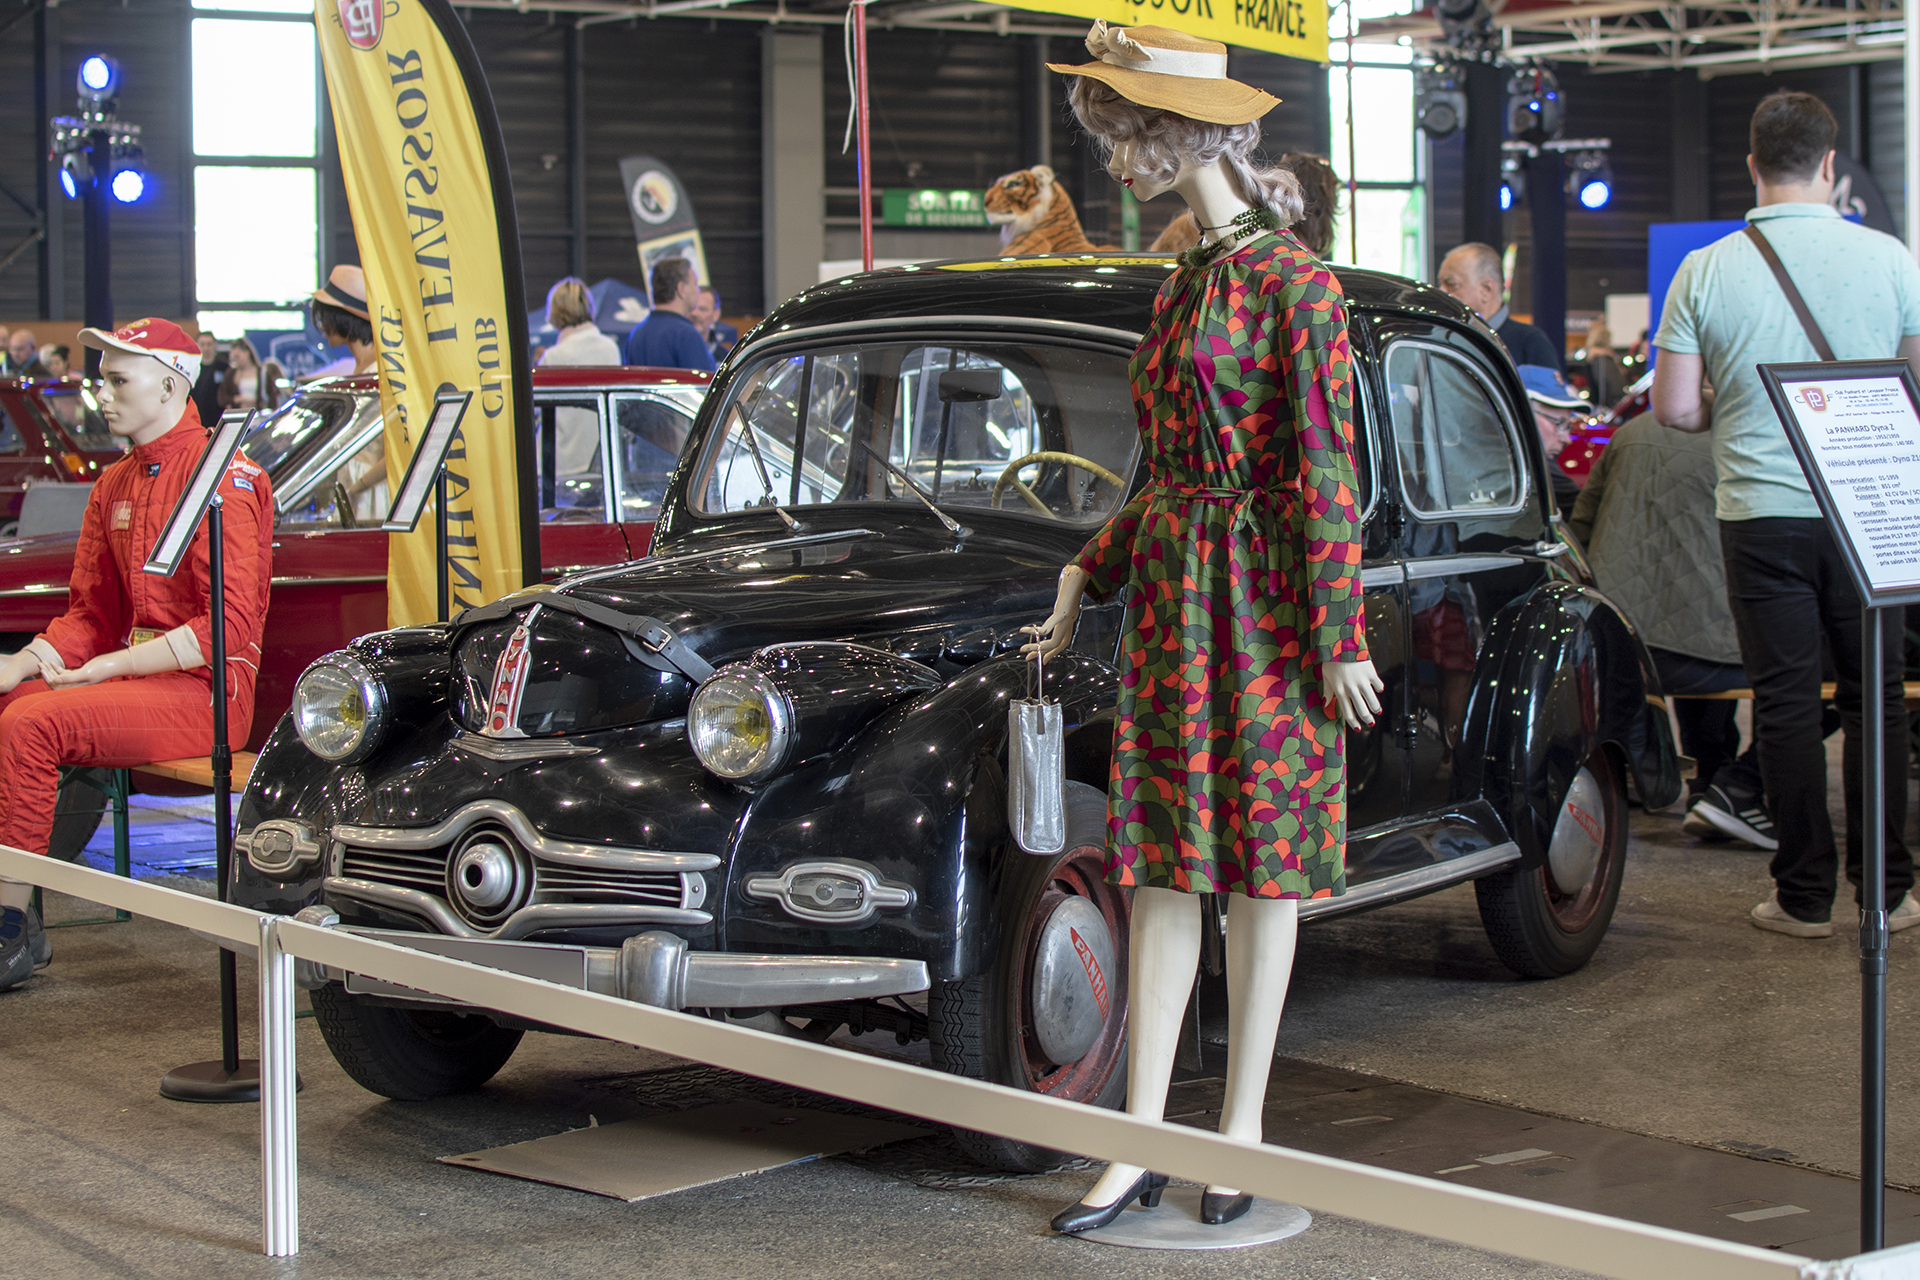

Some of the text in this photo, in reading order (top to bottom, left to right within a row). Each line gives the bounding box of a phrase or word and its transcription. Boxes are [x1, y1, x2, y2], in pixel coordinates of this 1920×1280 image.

[1235, 0, 1306, 38] FRANCE
[908, 190, 981, 210] SORTIE
[906, 213, 984, 225] DE SECOURS
[1835, 425, 1870, 434] PANHARD
[1825, 459, 1856, 468] Véhicule
[1857, 458, 1887, 466] présenté
[1892, 456, 1910, 464] Dyna
